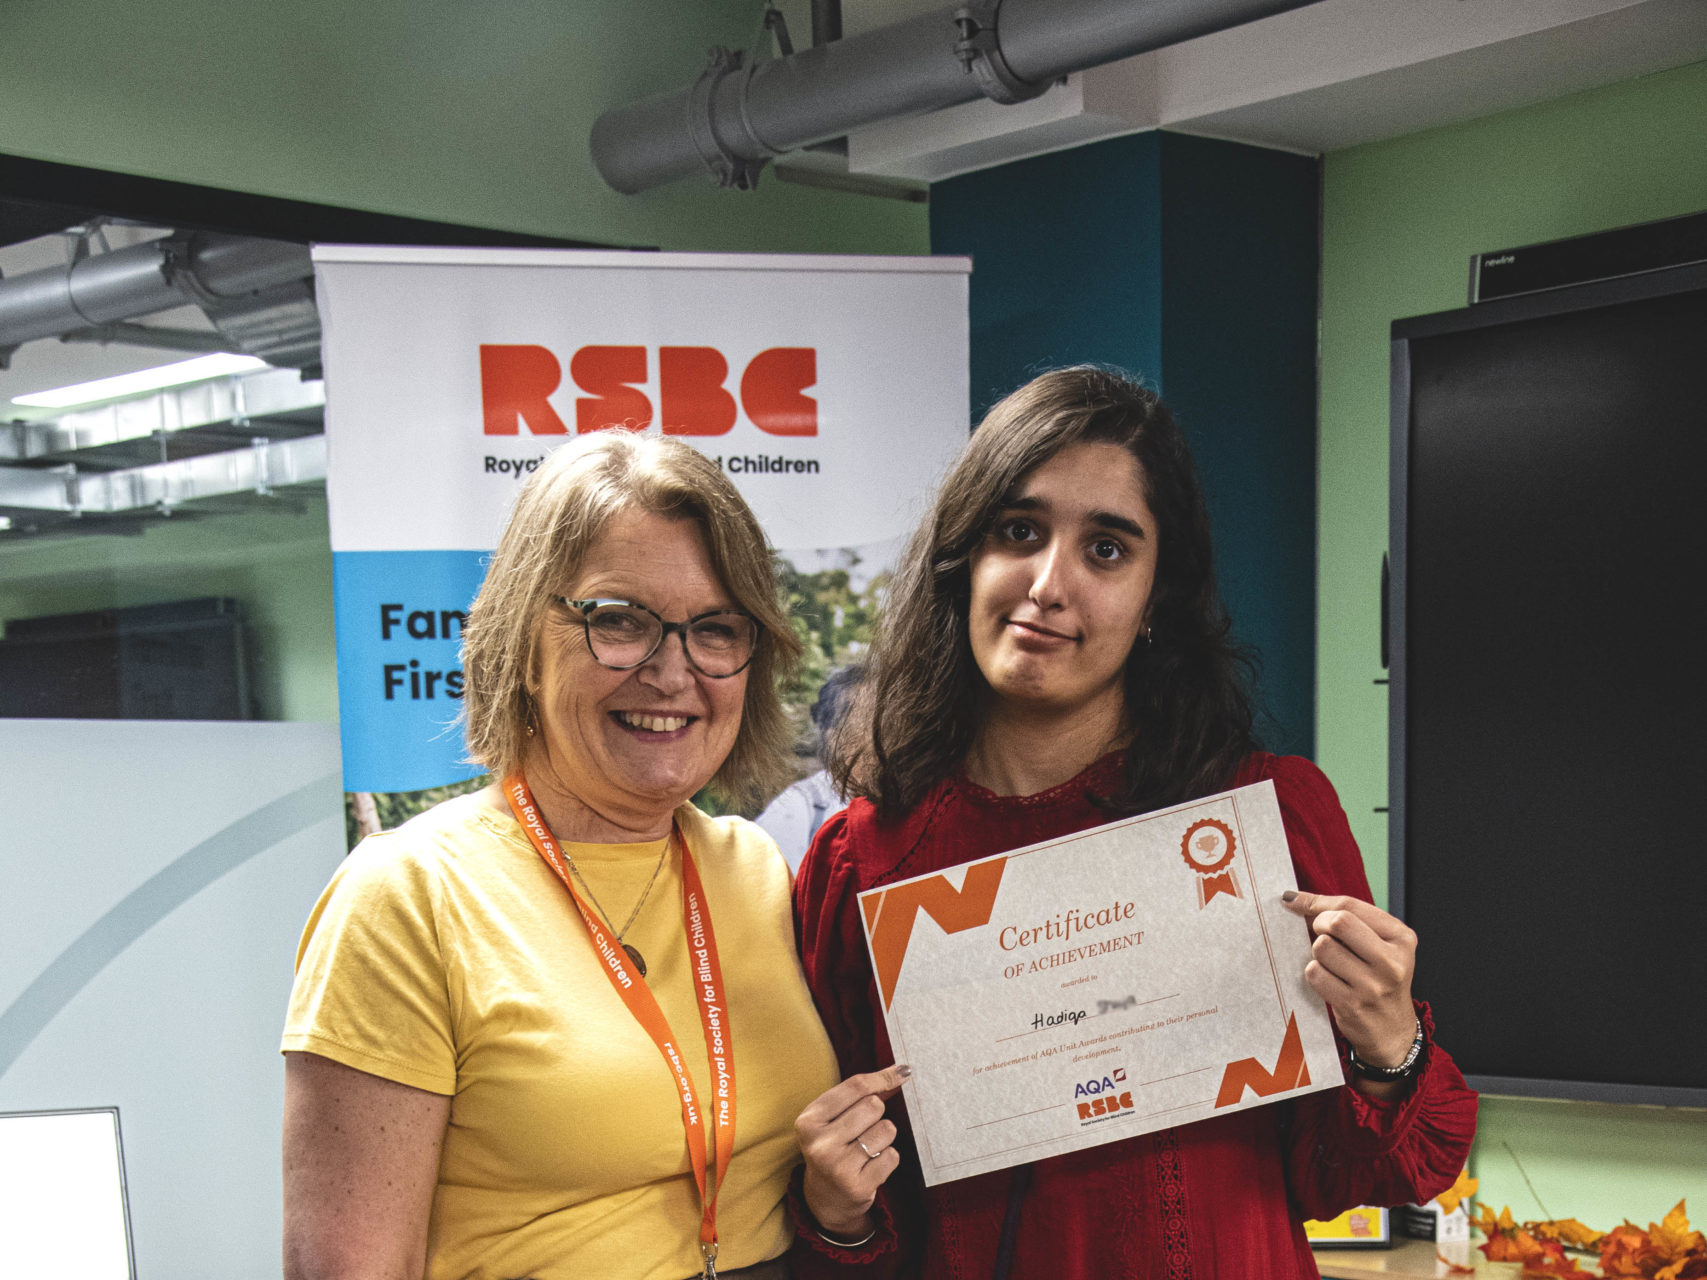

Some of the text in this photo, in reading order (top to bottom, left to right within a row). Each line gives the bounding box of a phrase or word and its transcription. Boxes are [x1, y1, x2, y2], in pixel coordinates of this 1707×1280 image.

[479, 344, 818, 437] RSBC
[484, 456, 545, 479] Roya
[728, 456, 820, 474] Children
[383, 659, 465, 700] Firs
[511, 783, 527, 806] The
[522, 806, 548, 841] Royal
[595, 932, 633, 989] Children
[999, 901, 1136, 951] Certificate
[1004, 931, 1145, 979] OF ACHIEVEMENT
[1061, 974, 1090, 988] awarded
[688, 893, 730, 1128] The Royal Society for Blind Children
[984, 1055, 1029, 1072] achievement
[1040, 1047, 1058, 1058] AQA
[1078, 1035, 1107, 1048] Awards
[1108, 1023, 1155, 1041] contributing
[1186, 1005, 1218, 1022] personal
[664, 1042, 698, 1126] rsbc.org.uk
[1075, 1076, 1115, 1099] AQA
[1077, 1091, 1134, 1120] RSBC
